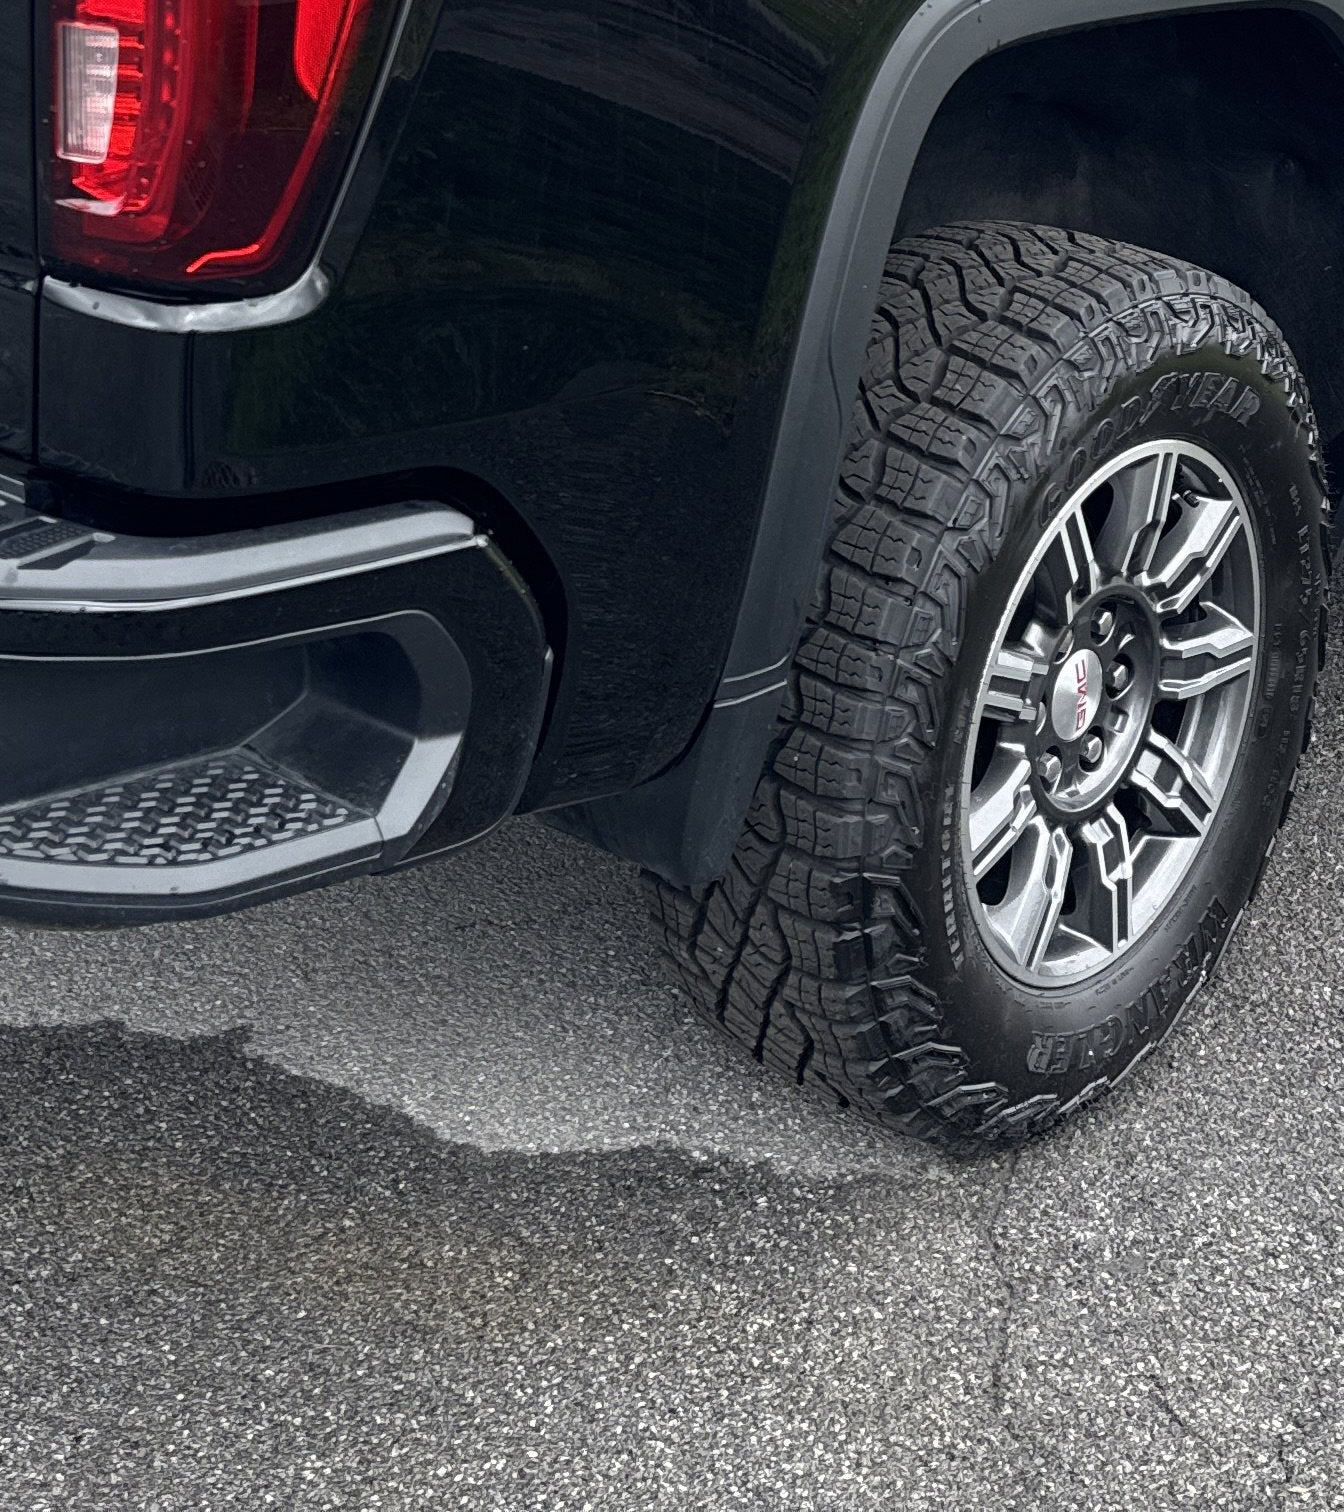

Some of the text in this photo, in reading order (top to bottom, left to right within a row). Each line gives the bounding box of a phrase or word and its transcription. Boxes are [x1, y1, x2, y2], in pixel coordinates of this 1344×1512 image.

[1040, 371, 1261, 530] GOODYEAR
[1075, 658, 1088, 733] GMC
[940, 781, 965, 972] TERRITORY
[1026, 895, 1229, 1076] WRANGLER
